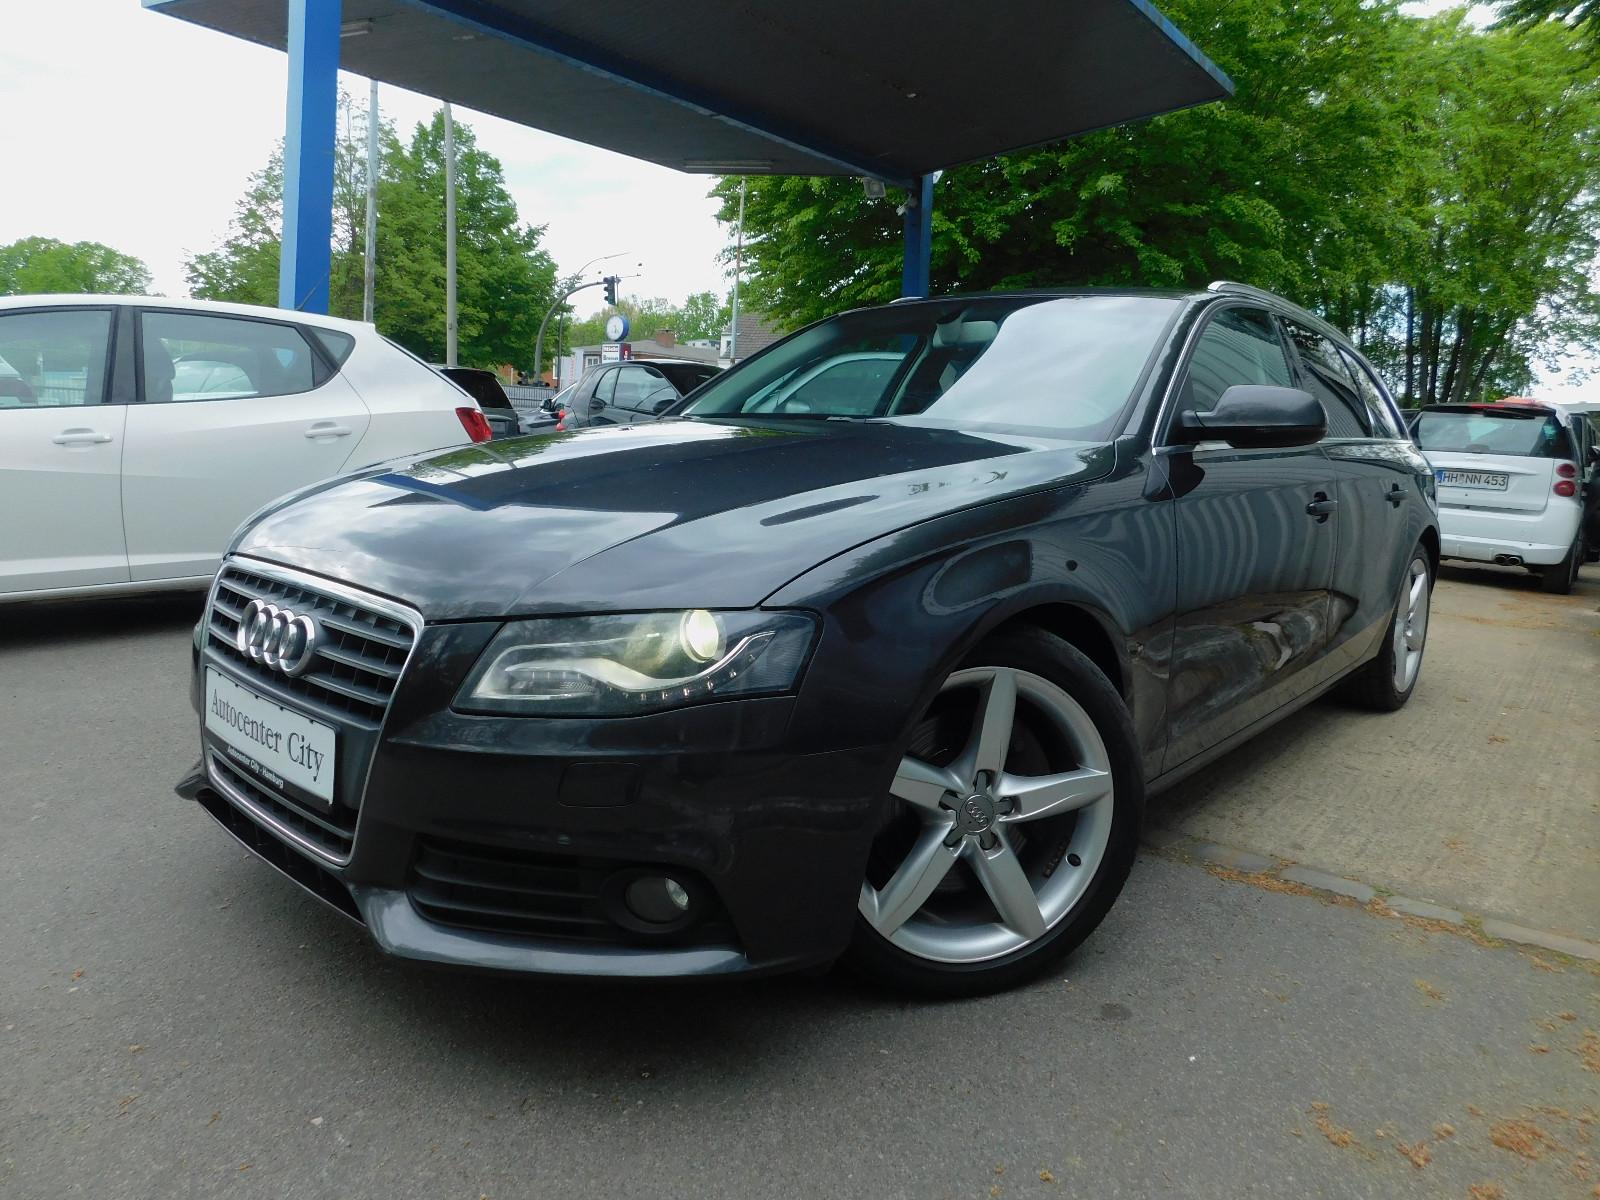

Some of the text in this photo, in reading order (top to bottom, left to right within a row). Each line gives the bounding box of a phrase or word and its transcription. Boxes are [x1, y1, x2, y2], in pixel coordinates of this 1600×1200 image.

[1443, 473, 1506, 486] HH NN 453
[211, 688, 325, 782] Autocenter City
